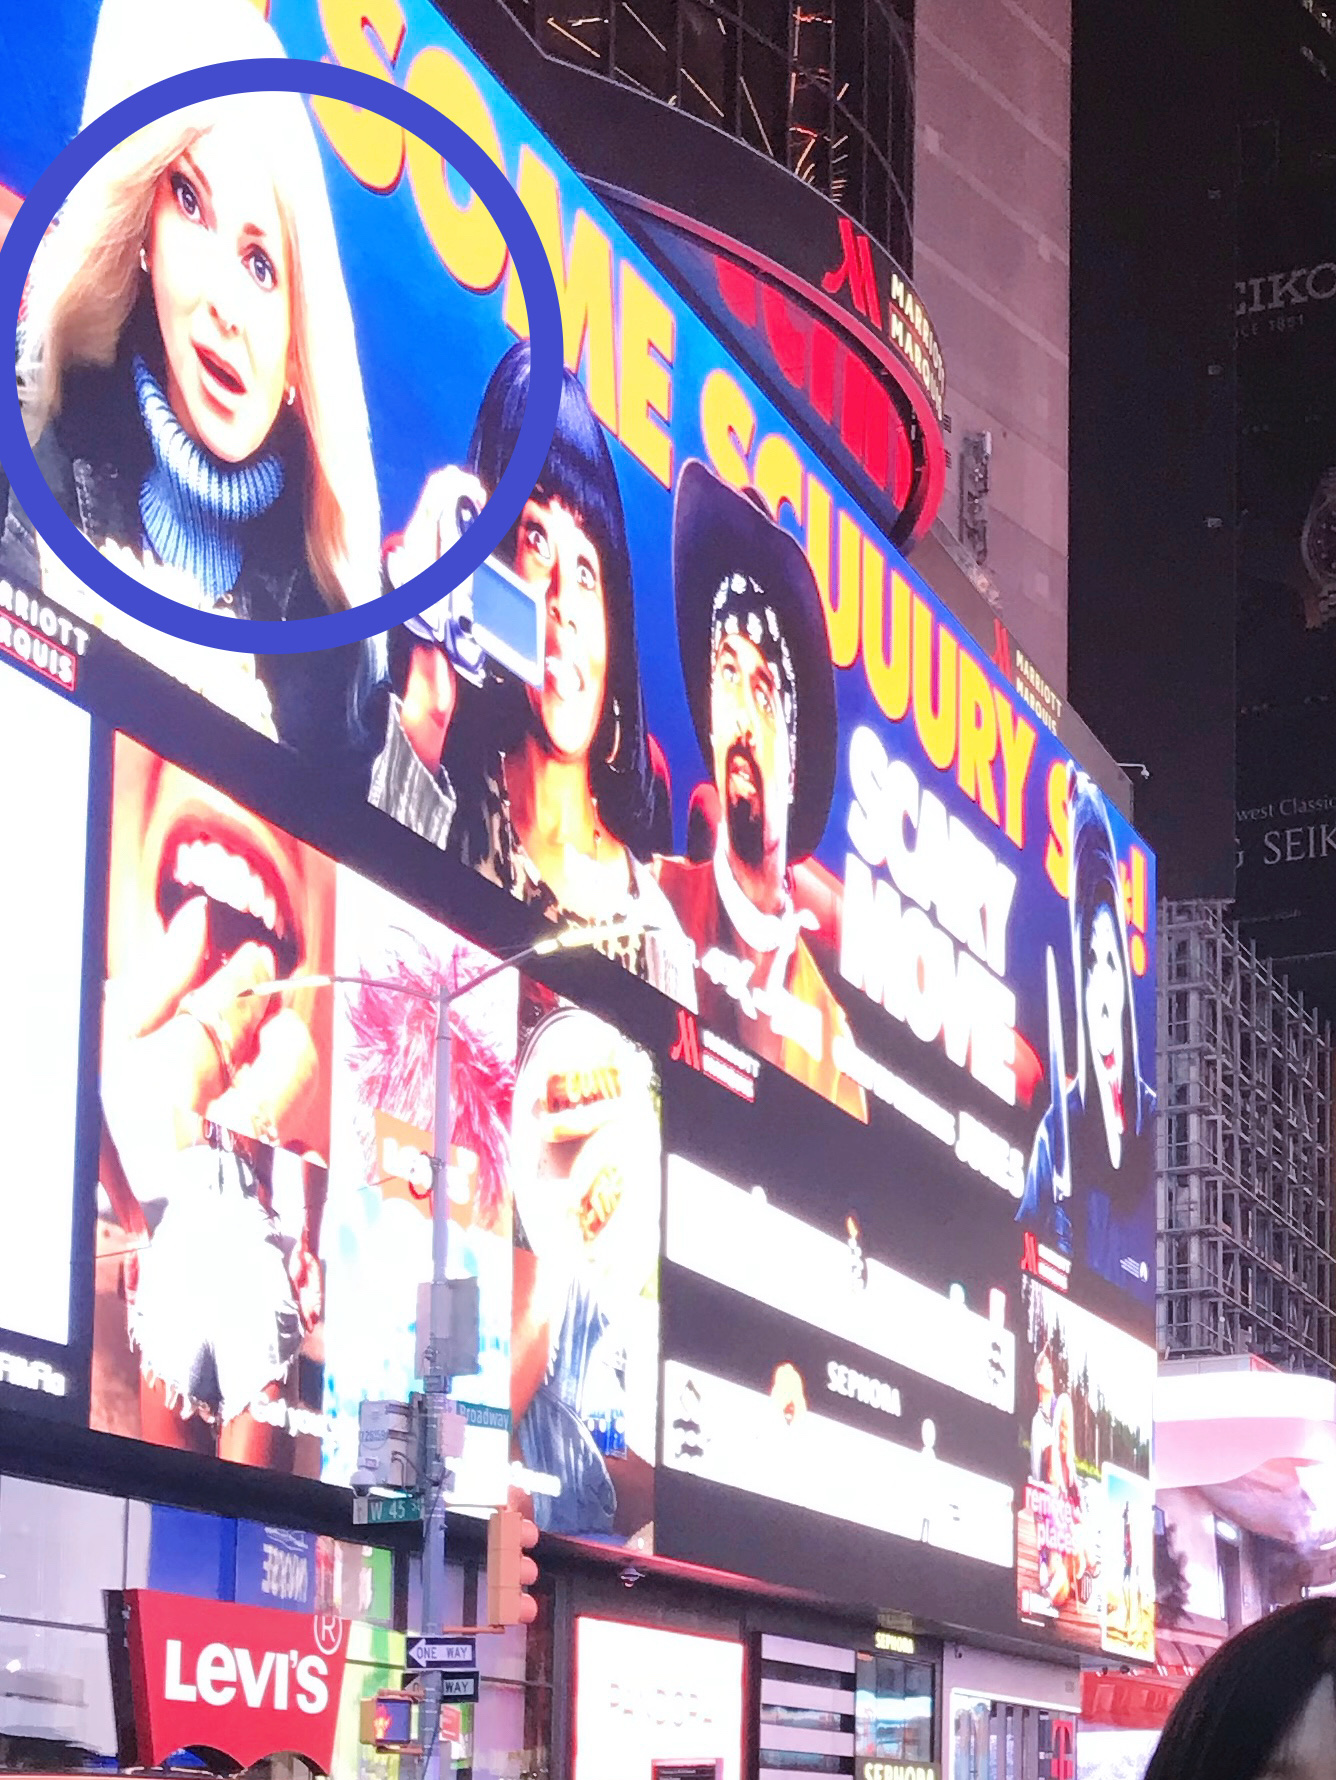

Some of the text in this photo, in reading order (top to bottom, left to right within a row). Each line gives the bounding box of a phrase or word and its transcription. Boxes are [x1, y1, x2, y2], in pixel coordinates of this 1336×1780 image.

[309, 0, 676, 493] SOME
[891, 273, 946, 396] MARRIOTT
[891, 313, 943, 421] MARQUIS
[1016, 649, 1062, 718] MARRIOTT
[1016, 676, 1058, 736] MARQUIS
[459, 1405, 510, 1428] Broadway
[370, 1504, 384, 1521] W
[388, 1501, 406, 1519] 45
[416, 1646, 468, 1660] ONE WAY
[874, 1631, 915, 1655] SEPHORA
[445, 1680, 469, 1693] WAY
